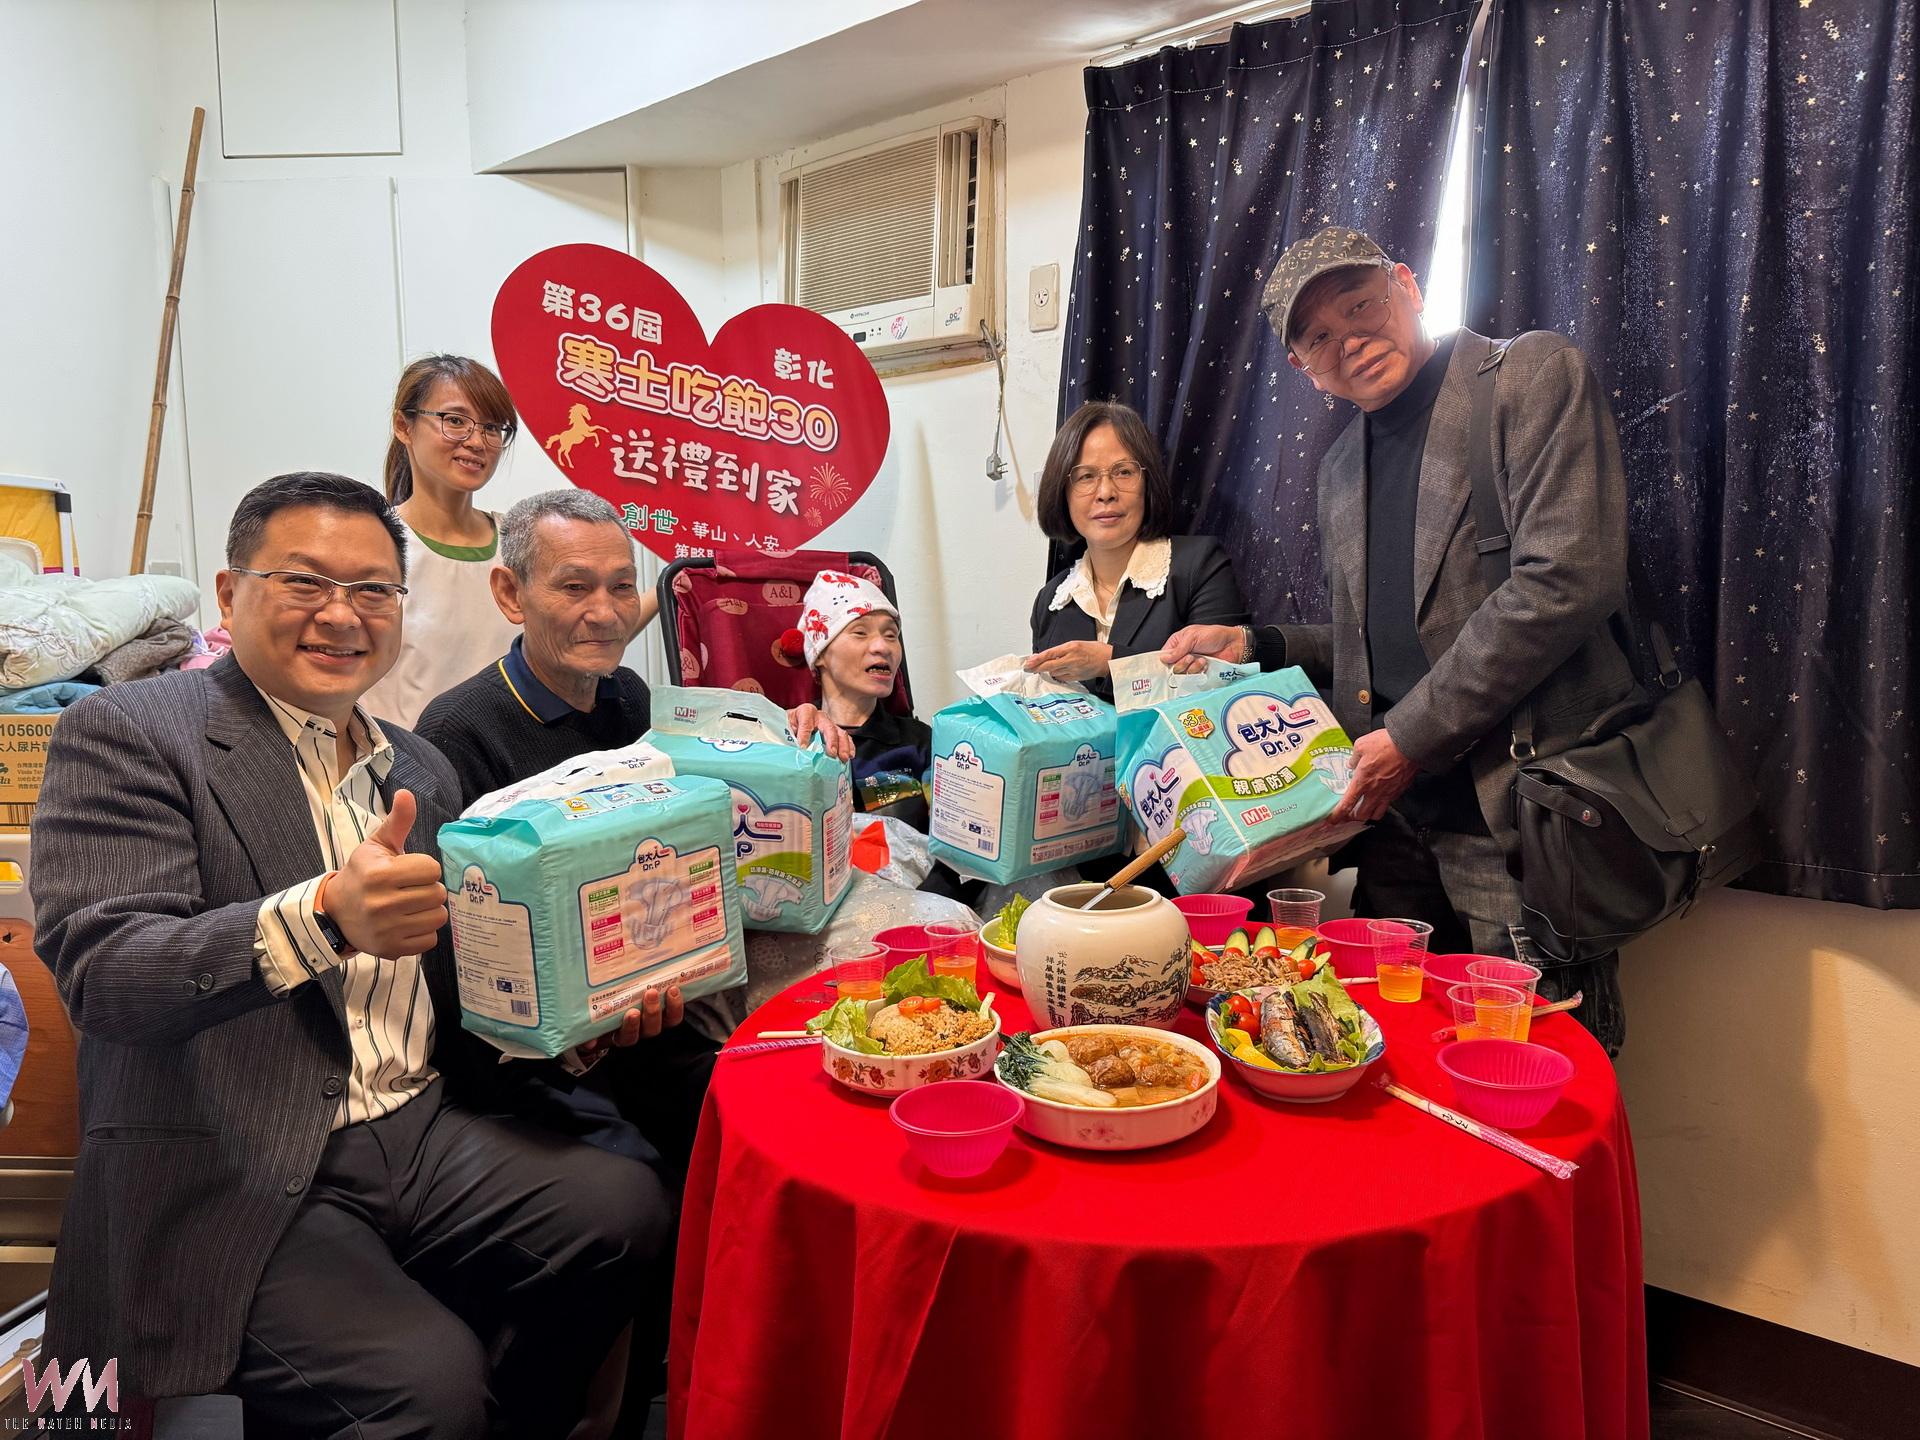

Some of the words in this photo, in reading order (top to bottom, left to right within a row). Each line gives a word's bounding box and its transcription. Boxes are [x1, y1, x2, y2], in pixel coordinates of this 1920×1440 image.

[541, 280, 663, 345] 第36屆
[773, 348, 835, 390] 彰化
[557, 334, 838, 451] 寒士吃飽30
[609, 428, 802, 517] 送禮到家
[770, 586, 793, 599] A&I
[1237, 712, 1316, 743] 包大人
[1140, 777, 1180, 818] 包大人
[1233, 766, 1297, 796] 親膚防漏
[1244, 809, 1258, 823] M
